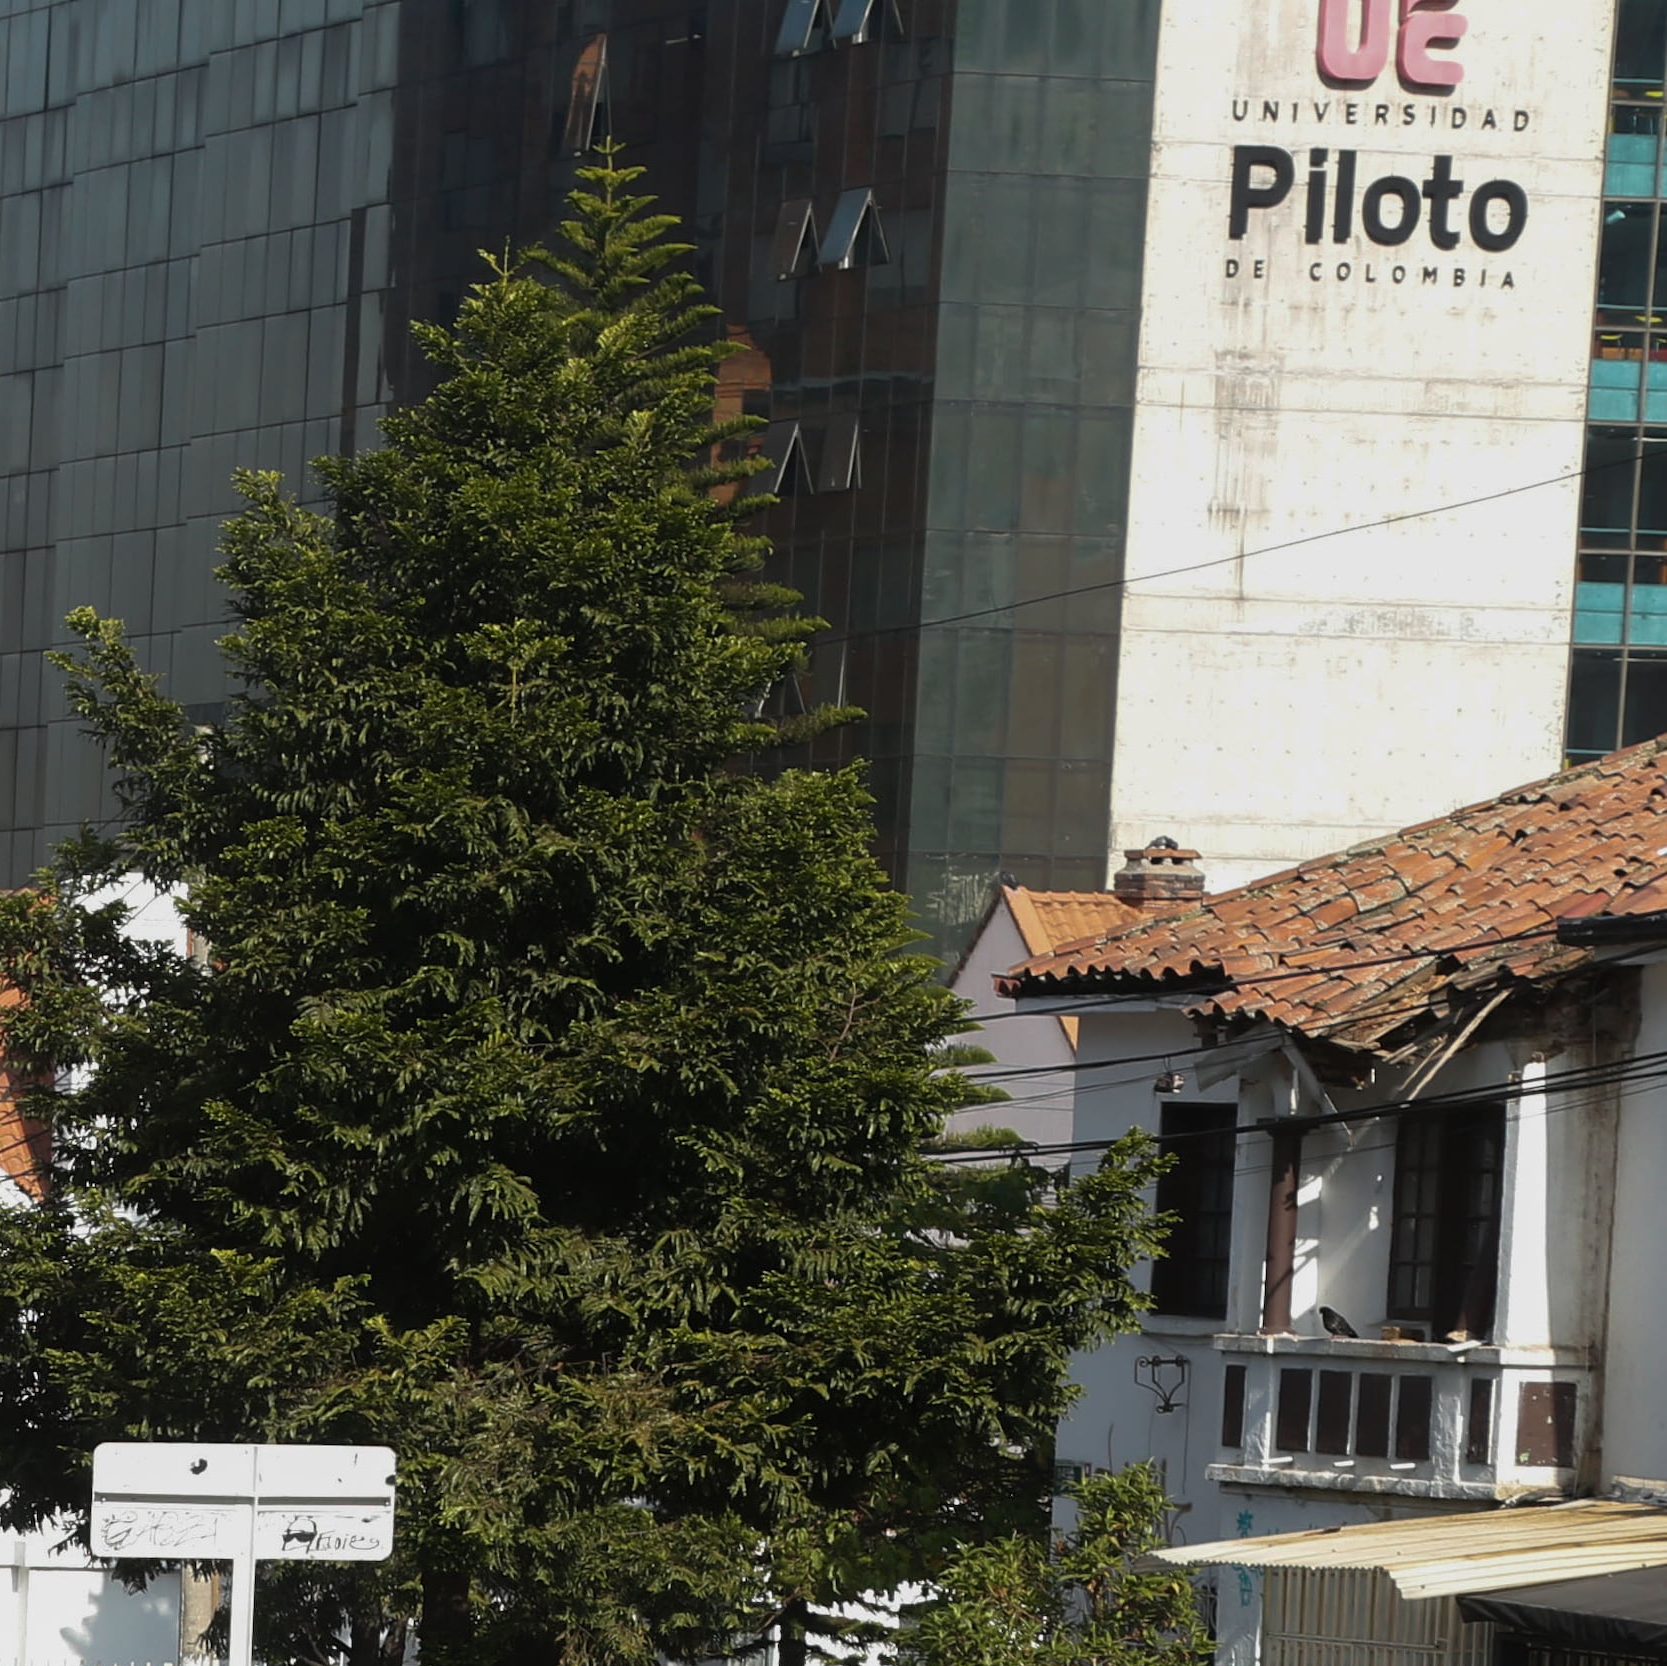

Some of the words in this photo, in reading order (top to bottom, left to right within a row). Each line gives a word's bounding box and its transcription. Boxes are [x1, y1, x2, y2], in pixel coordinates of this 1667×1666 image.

[1233, 100, 1530, 131] UNIVERSIDAD
[1228, 144, 1529, 253] Piloto
[1225, 259, 1265, 279] DE
[1309, 262, 1516, 289] COLOMBIA
